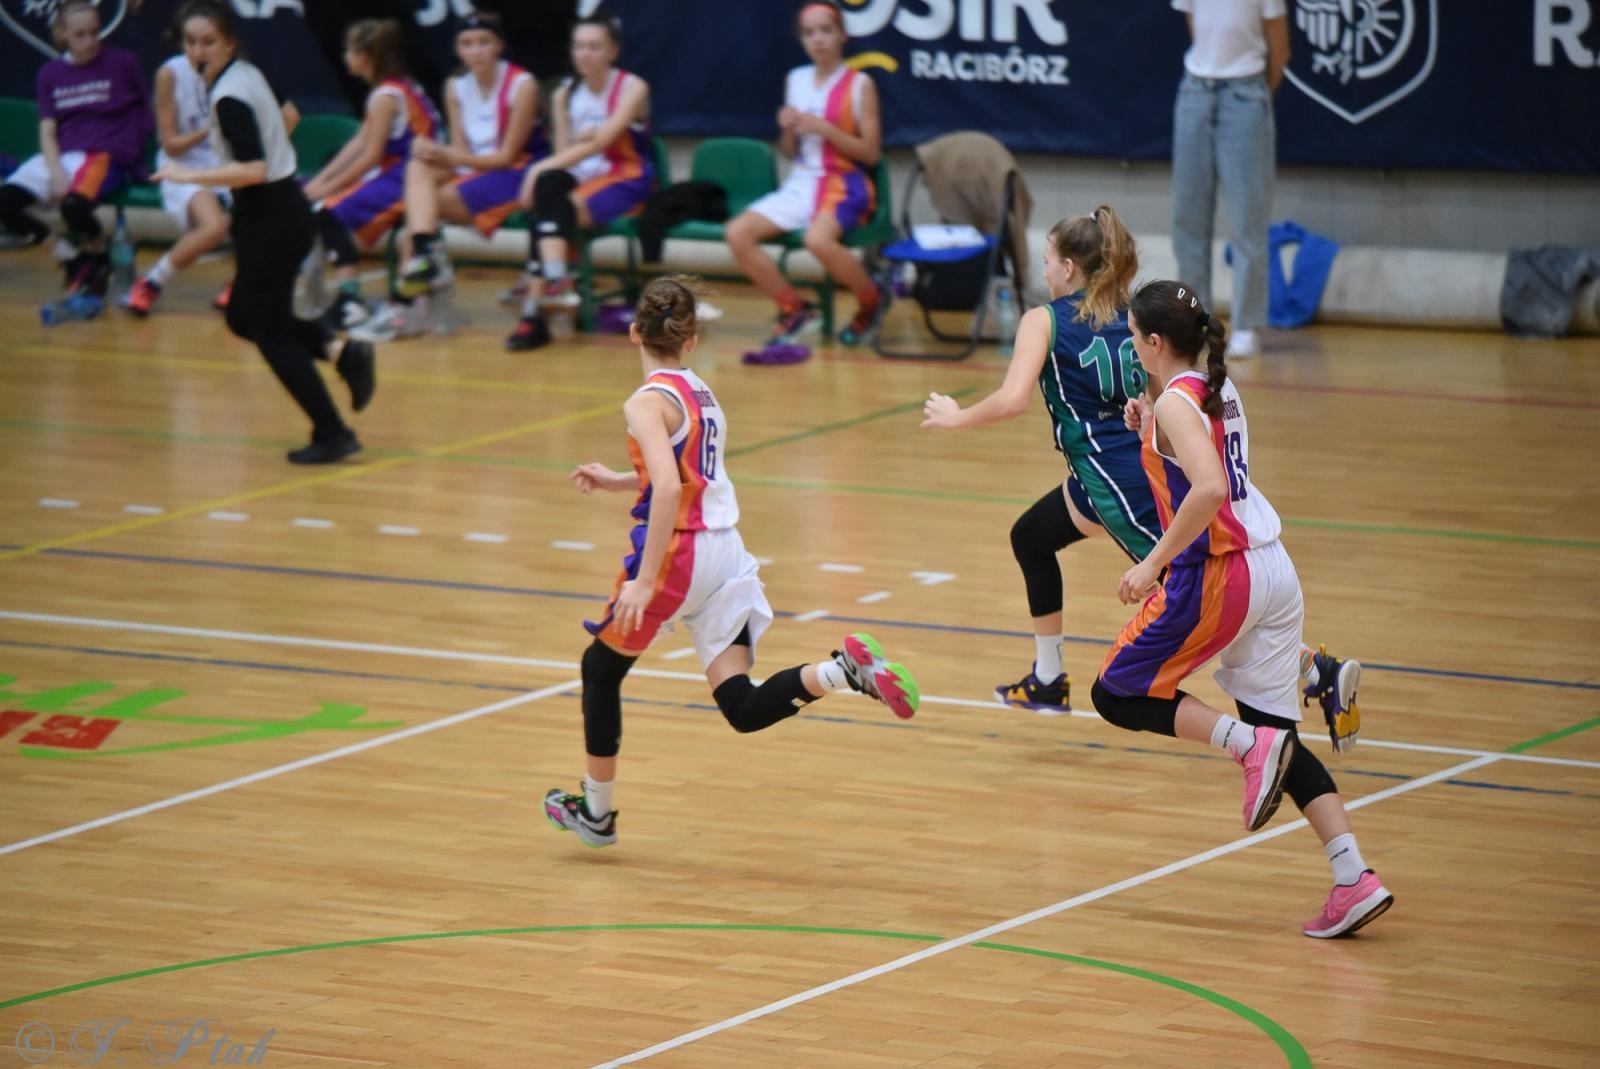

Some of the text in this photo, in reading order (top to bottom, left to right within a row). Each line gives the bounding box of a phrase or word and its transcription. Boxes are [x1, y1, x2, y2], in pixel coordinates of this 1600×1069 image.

[909, 45, 1070, 86] RACIBÓRZ
[1078, 335, 1149, 402] 16
[698, 417, 719, 482] 16
[1223, 430, 1249, 503] 13
